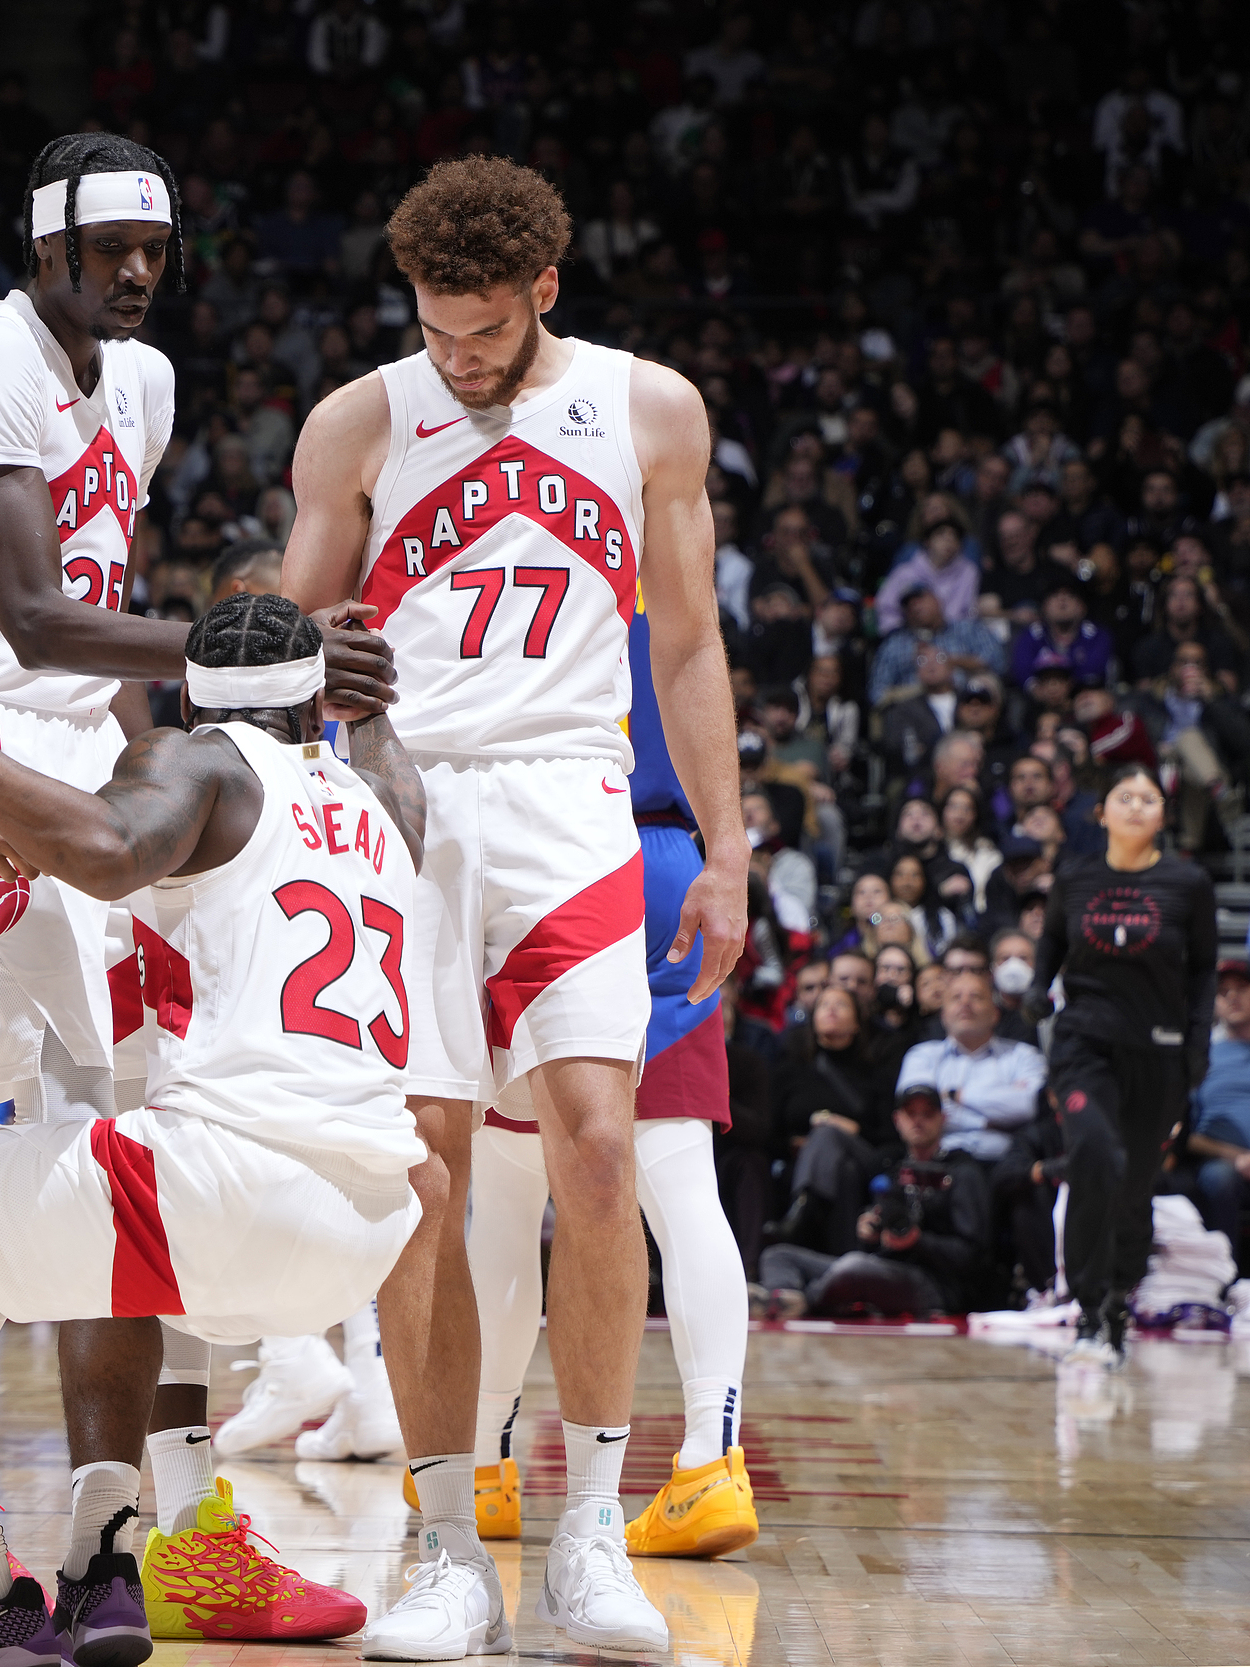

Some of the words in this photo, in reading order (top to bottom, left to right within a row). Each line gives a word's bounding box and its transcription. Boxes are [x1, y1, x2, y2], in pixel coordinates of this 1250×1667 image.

[559, 425, 582, 437] Sun
[584, 427, 606, 438] Life
[56, 452, 136, 538] APTOR
[402, 459, 623, 577] RAPTORS
[450, 565, 571, 660] 77
[291, 803, 386, 875] SEAD
[271, 879, 411, 1071] 23
